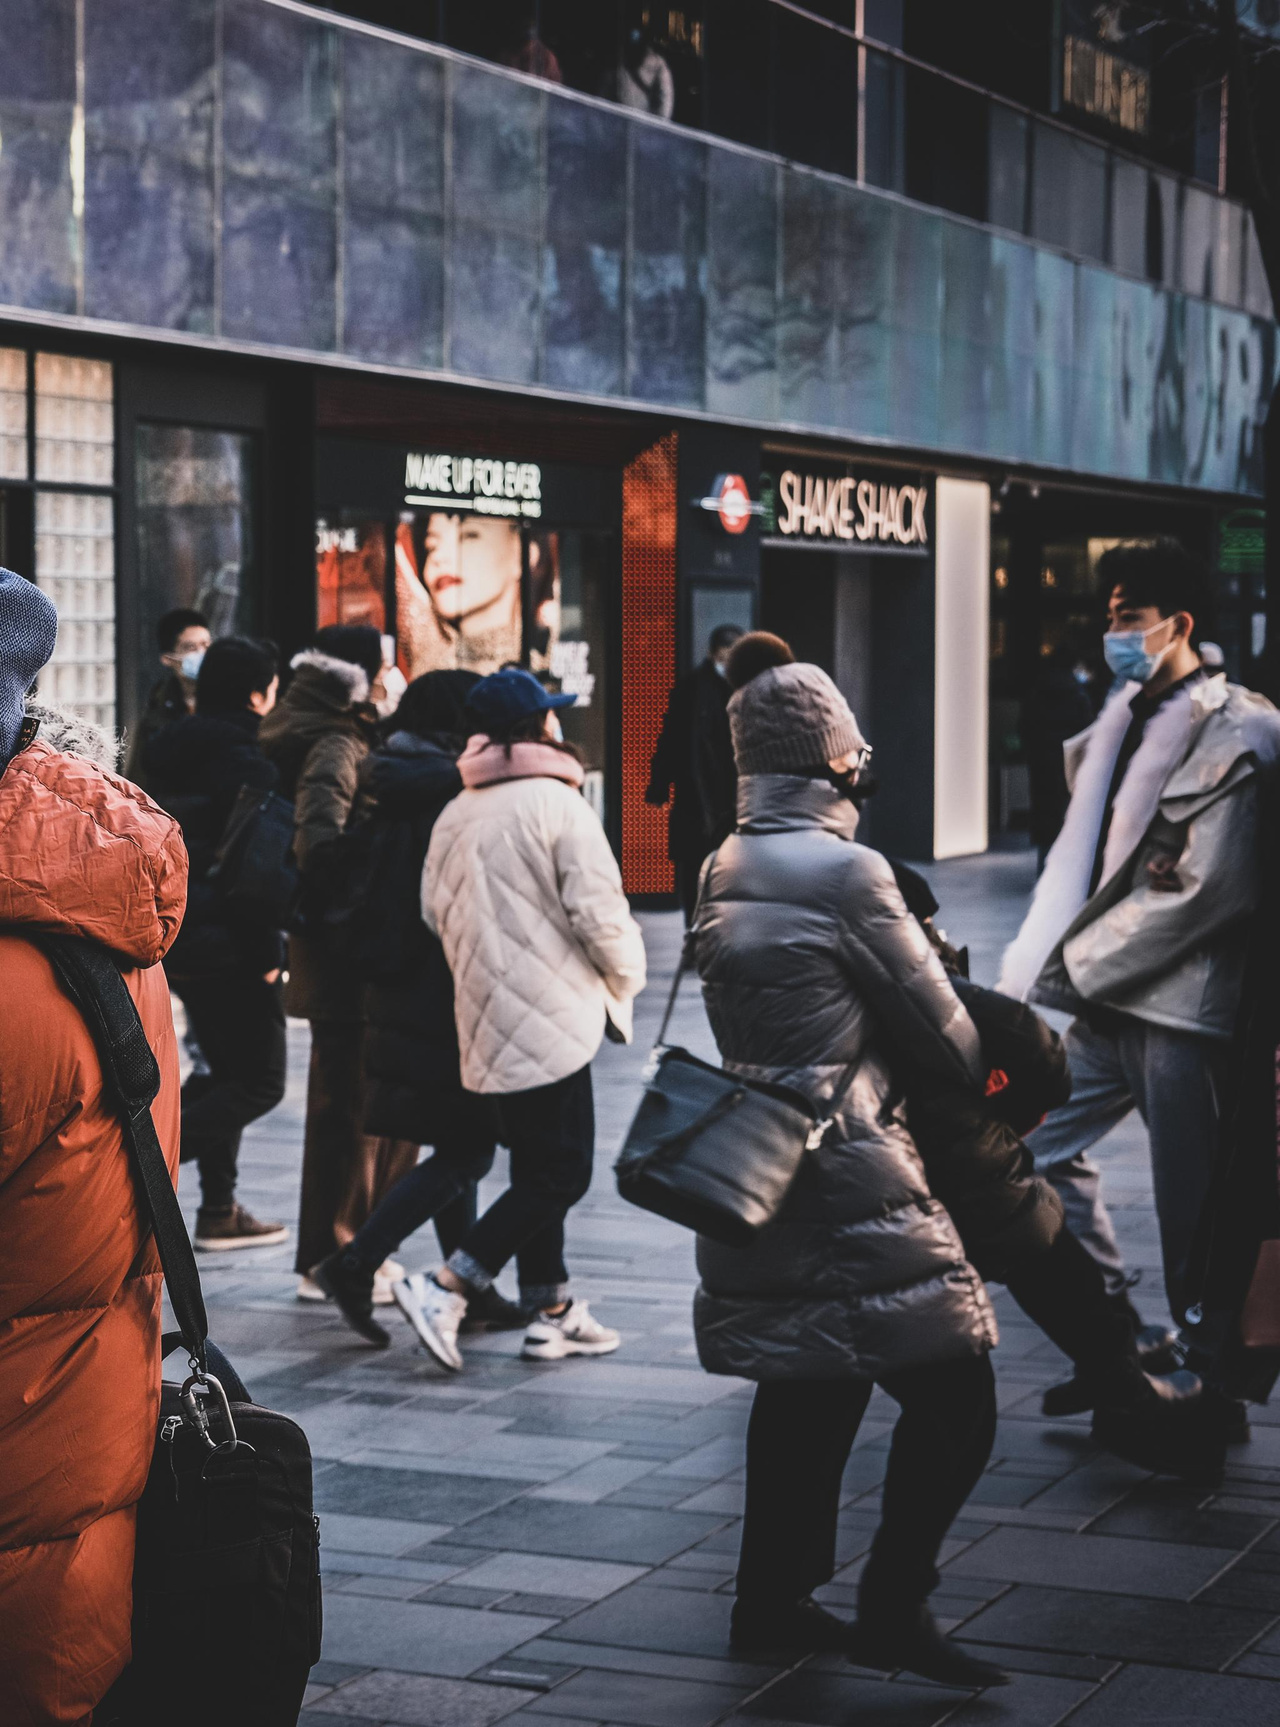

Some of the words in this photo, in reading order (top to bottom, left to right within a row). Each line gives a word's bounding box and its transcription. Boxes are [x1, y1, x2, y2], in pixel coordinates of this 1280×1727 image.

[405, 452, 452, 493] MAKE
[452, 456, 473, 494] UP
[778, 469, 856, 540] SHAKE
[856, 479, 927, 544] SHACK
